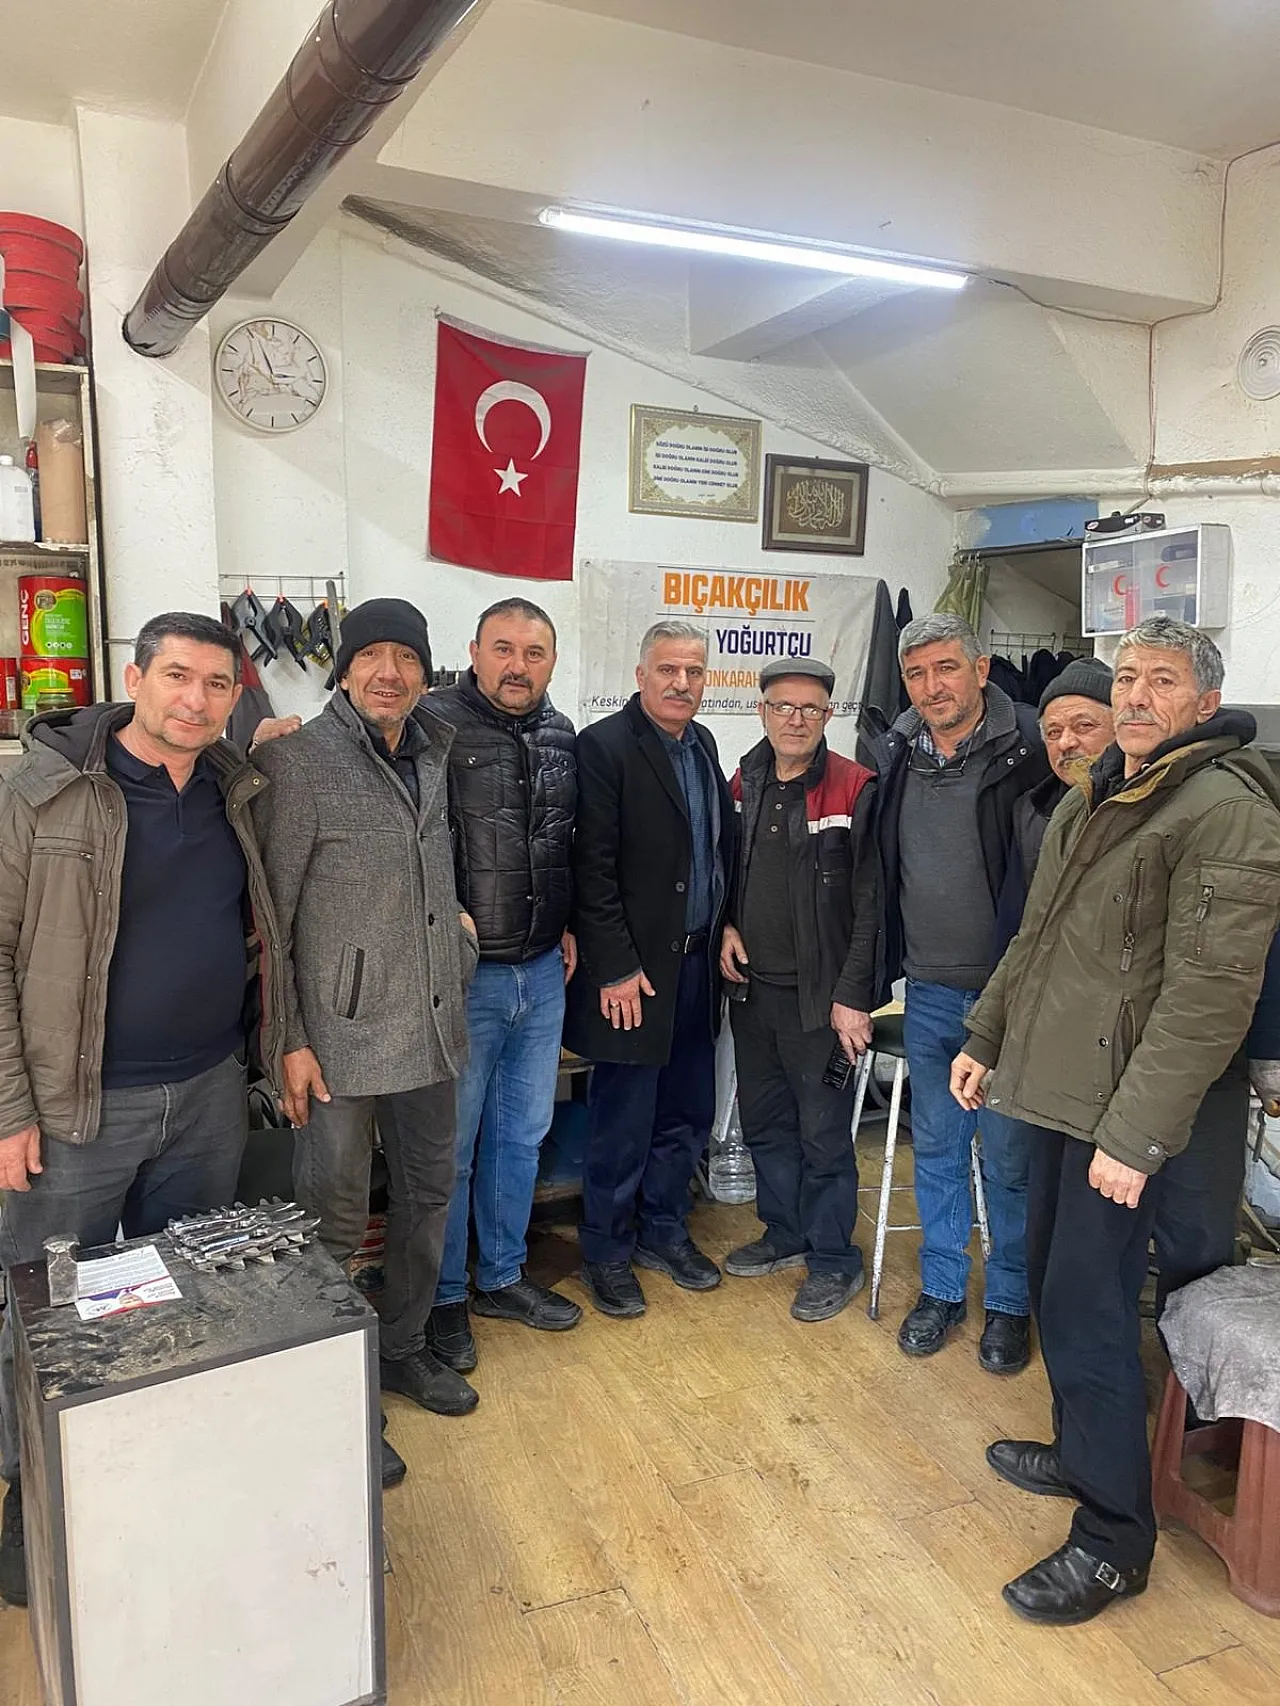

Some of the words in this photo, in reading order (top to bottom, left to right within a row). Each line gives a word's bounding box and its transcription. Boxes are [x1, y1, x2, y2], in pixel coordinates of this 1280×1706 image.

[663, 572, 812, 616] BIÇAKÇILIK
[20, 589, 30, 646] GENÇ
[716, 625, 812, 658] YOĞURTÇU
[704, 669, 760, 688] ONKARAH
[701, 697, 743, 709] atından,
